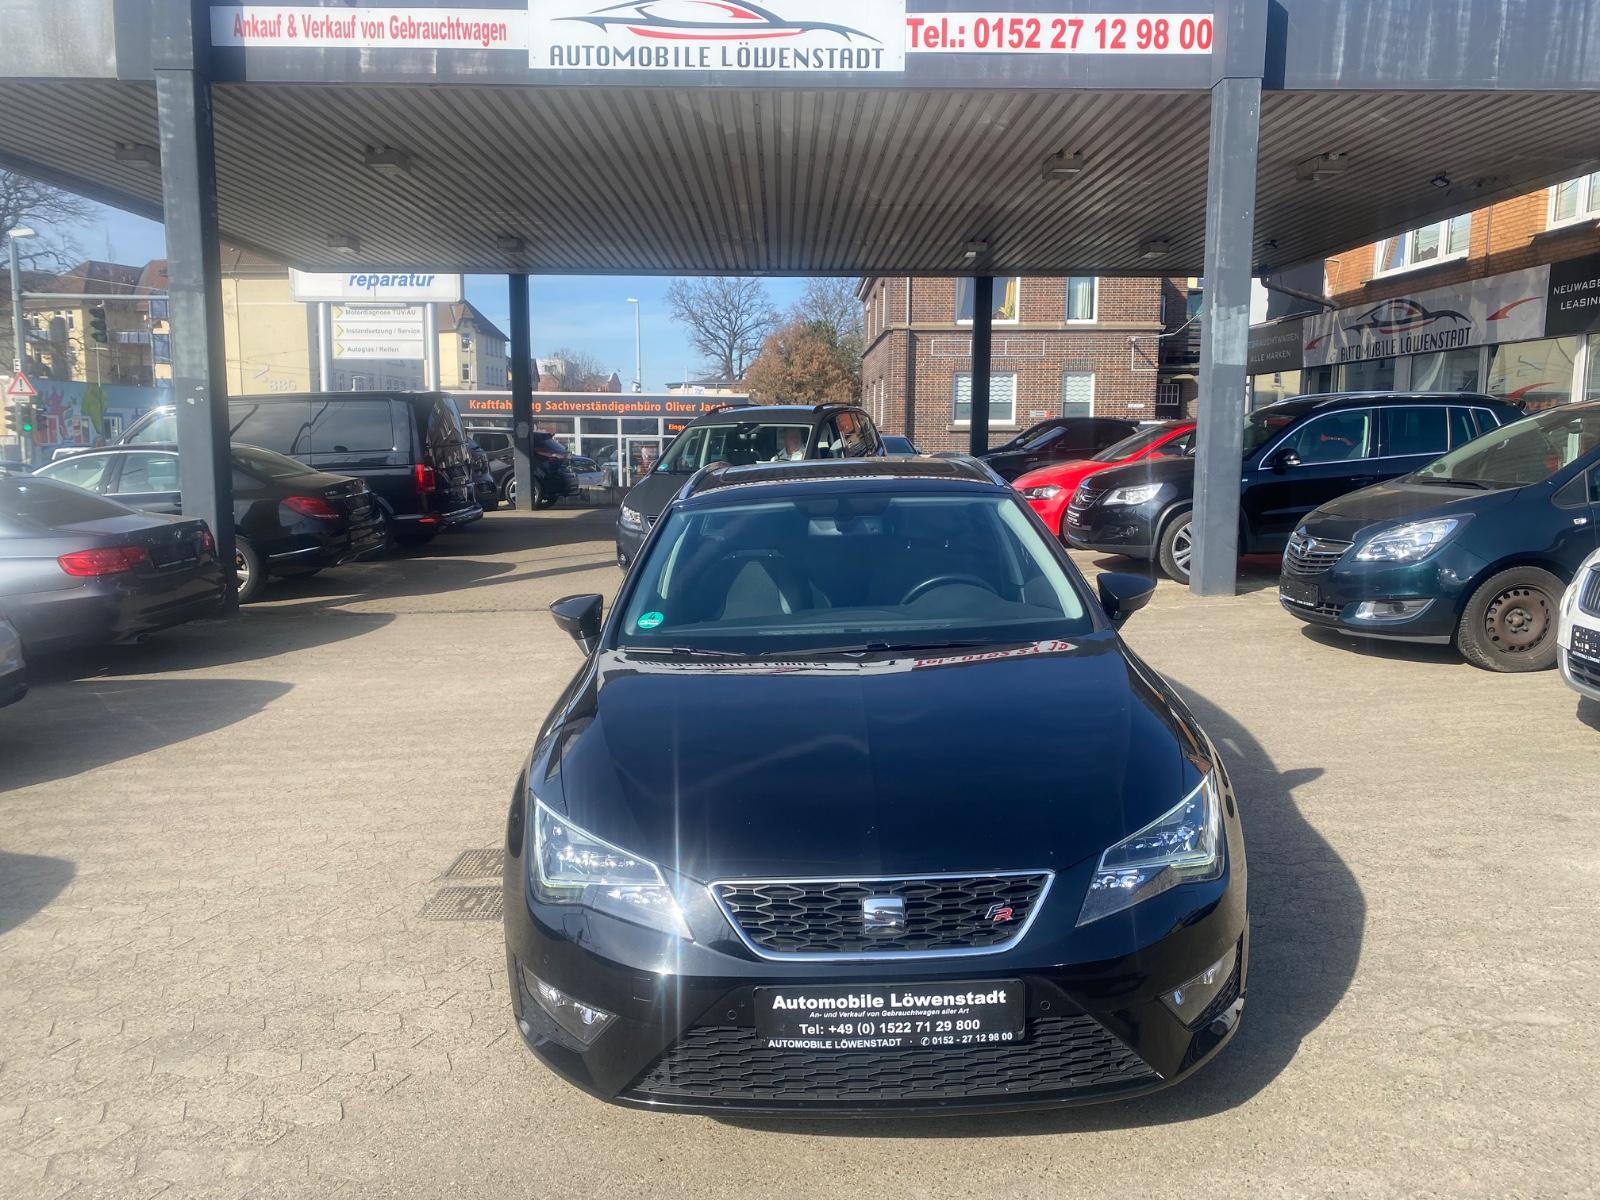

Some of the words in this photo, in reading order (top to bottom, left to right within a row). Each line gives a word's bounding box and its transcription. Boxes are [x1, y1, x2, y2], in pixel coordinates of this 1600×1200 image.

[233, 13, 282, 38] Ankauf
[287, 16, 297, 38] &
[302, 14, 356, 39] Verkauf
[361, 20, 385, 39] von
[389, 15, 507, 47] Gebrauchtwagen
[906, 18, 965, 48] Tel.:
[973, 18, 1041, 49] 0152
[1051, 19, 1084, 49] 27
[1095, 19, 1126, 49] 12
[1136, 19, 1169, 49] 98
[1179, 19, 1212, 49] 00
[550, 45, 711, 68] AUTOMOBILE
[722, 41, 884, 69] LÖWENSTADT
[349, 272, 435, 290] reparatur
[1561, 296, 1600, 310] LEASIN
[1401, 327, 1472, 354] LÖWENSTADT
[545, 401, 661, 413] Sachverständigenbüro
[665, 402, 696, 411] Oliver
[772, 994, 884, 1010] Automobile
[891, 990, 1006, 1008] Löwenstadt
[881, 1009, 940, 1017] Gebrauchtwagen
[799, 1023, 824, 1035] Tel:
[828, 1023, 853, 1035] +49
[857, 1021, 875, 1036] (0)
[879, 1021, 911, 1034] 1522
[915, 1021, 931, 1033] 71
[935, 1020, 952, 1032] 29
[955, 1019, 981, 1031] 800
[768, 1039, 832, 1049] AUTOMOBILE
[834, 1038, 902, 1049] LÖWENSTADT
[932, 1035, 954, 1046] 0152
[962, 1035, 975, 1045] 27
[976, 1034, 988, 1044] 12
[988, 1032, 1000, 1043] 98
[1001, 1031, 1013, 1042] 00
